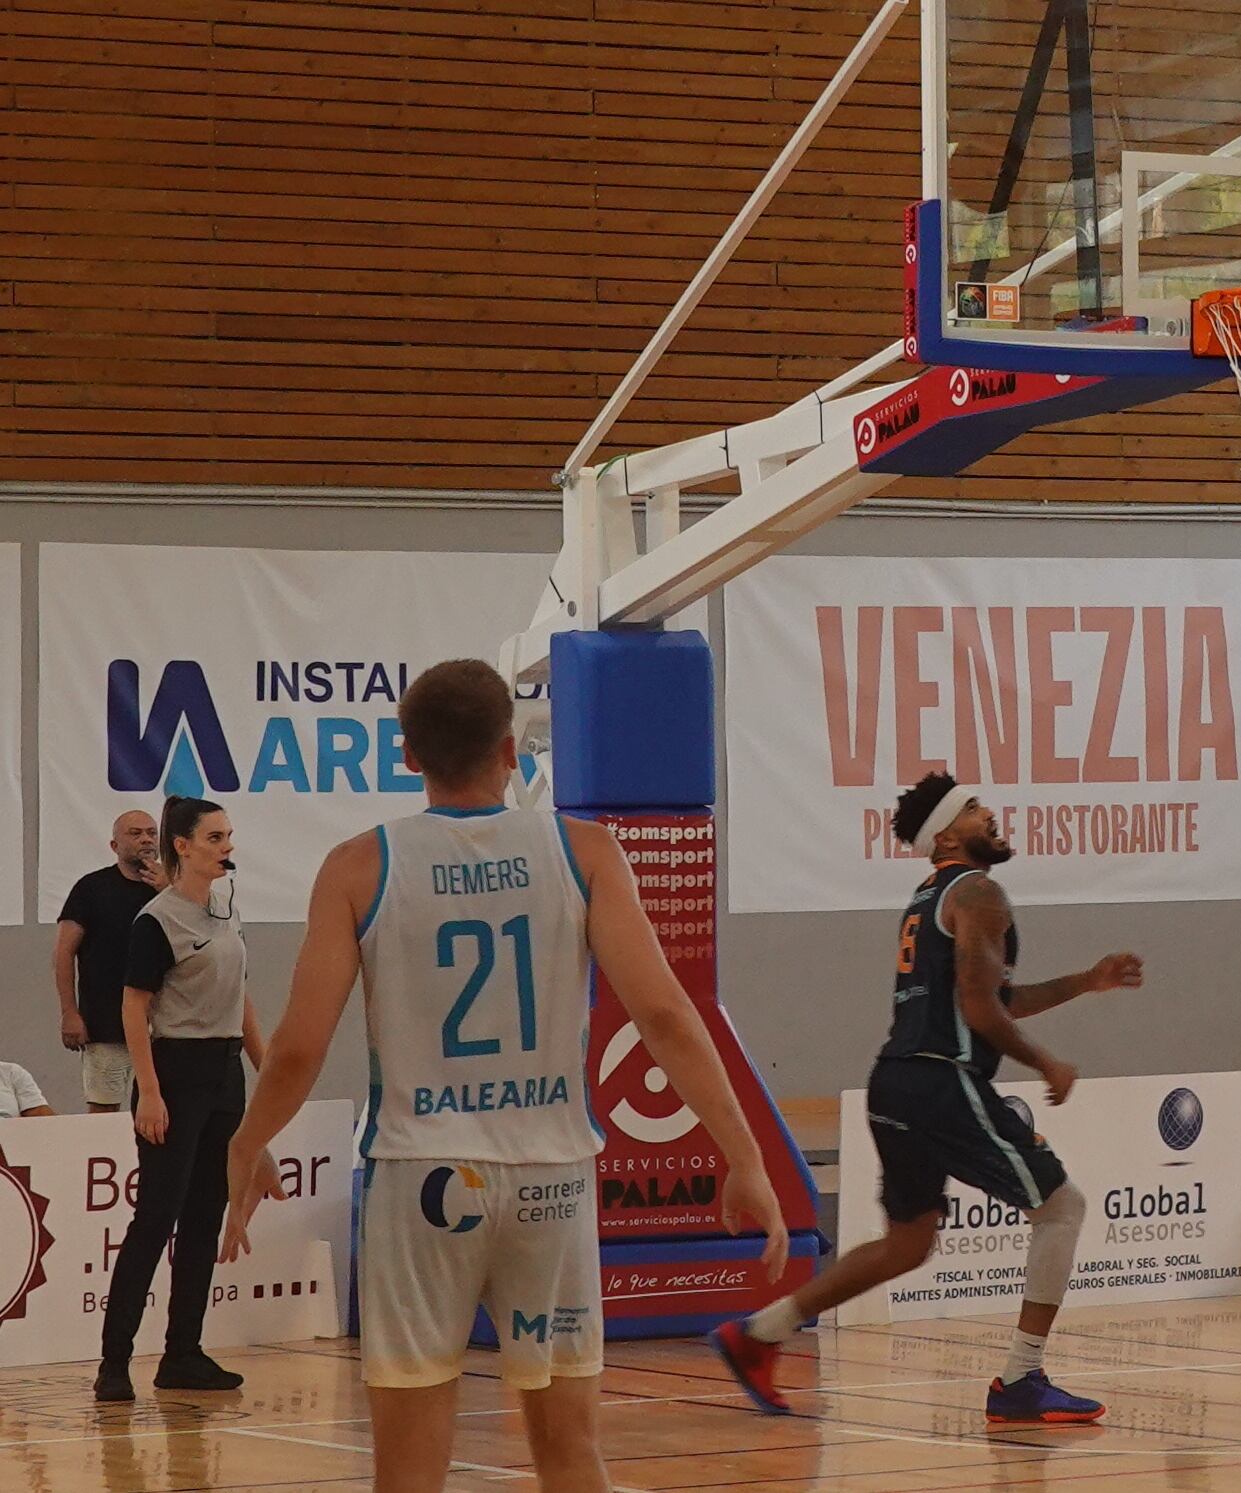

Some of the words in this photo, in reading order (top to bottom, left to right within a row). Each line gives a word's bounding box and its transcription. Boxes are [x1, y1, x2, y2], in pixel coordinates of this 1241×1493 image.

[971, 373, 1017, 400] PALAU
[875, 390, 919, 421] SERVICIOS
[878, 402, 921, 443] PALAU
[816, 606, 1239, 786] VENEZIA
[607, 822, 714, 845] #somsport
[1026, 803, 1199, 857] RISTORANTE
[624, 847, 714, 869] omsport
[432, 857, 530, 896] DEMERS
[635, 871, 714, 892] msport
[641, 895, 714, 916] msport
[658, 919, 714, 940] sport
[437, 914, 537, 1058] 21
[414, 1075, 569, 1117] BALEARIA
[599, 1155, 717, 1173] SERVICIOS
[518, 1178, 586, 1202] carreras
[602, 1174, 717, 1210] PALAU
[1104, 1182, 1207, 1220] Global
[517, 1201, 579, 1223] center
[1104, 1218, 1206, 1245] Asesores
[607, 1274, 623, 1292] lo
[629, 1273, 659, 1291] que
[665, 1268, 748, 1287] necesitas
[936, 1269, 974, 1283] FISCAL
[976, 1269, 985, 1281] Y
[1077, 1258, 1124, 1274] LABORAL
[1127, 1259, 1134, 1270] Y
[1164, 1254, 1202, 1267] SOCIAL
[1068, 1277, 1105, 1291] GUROS
[1107, 1272, 1167, 1288] GENERALES
